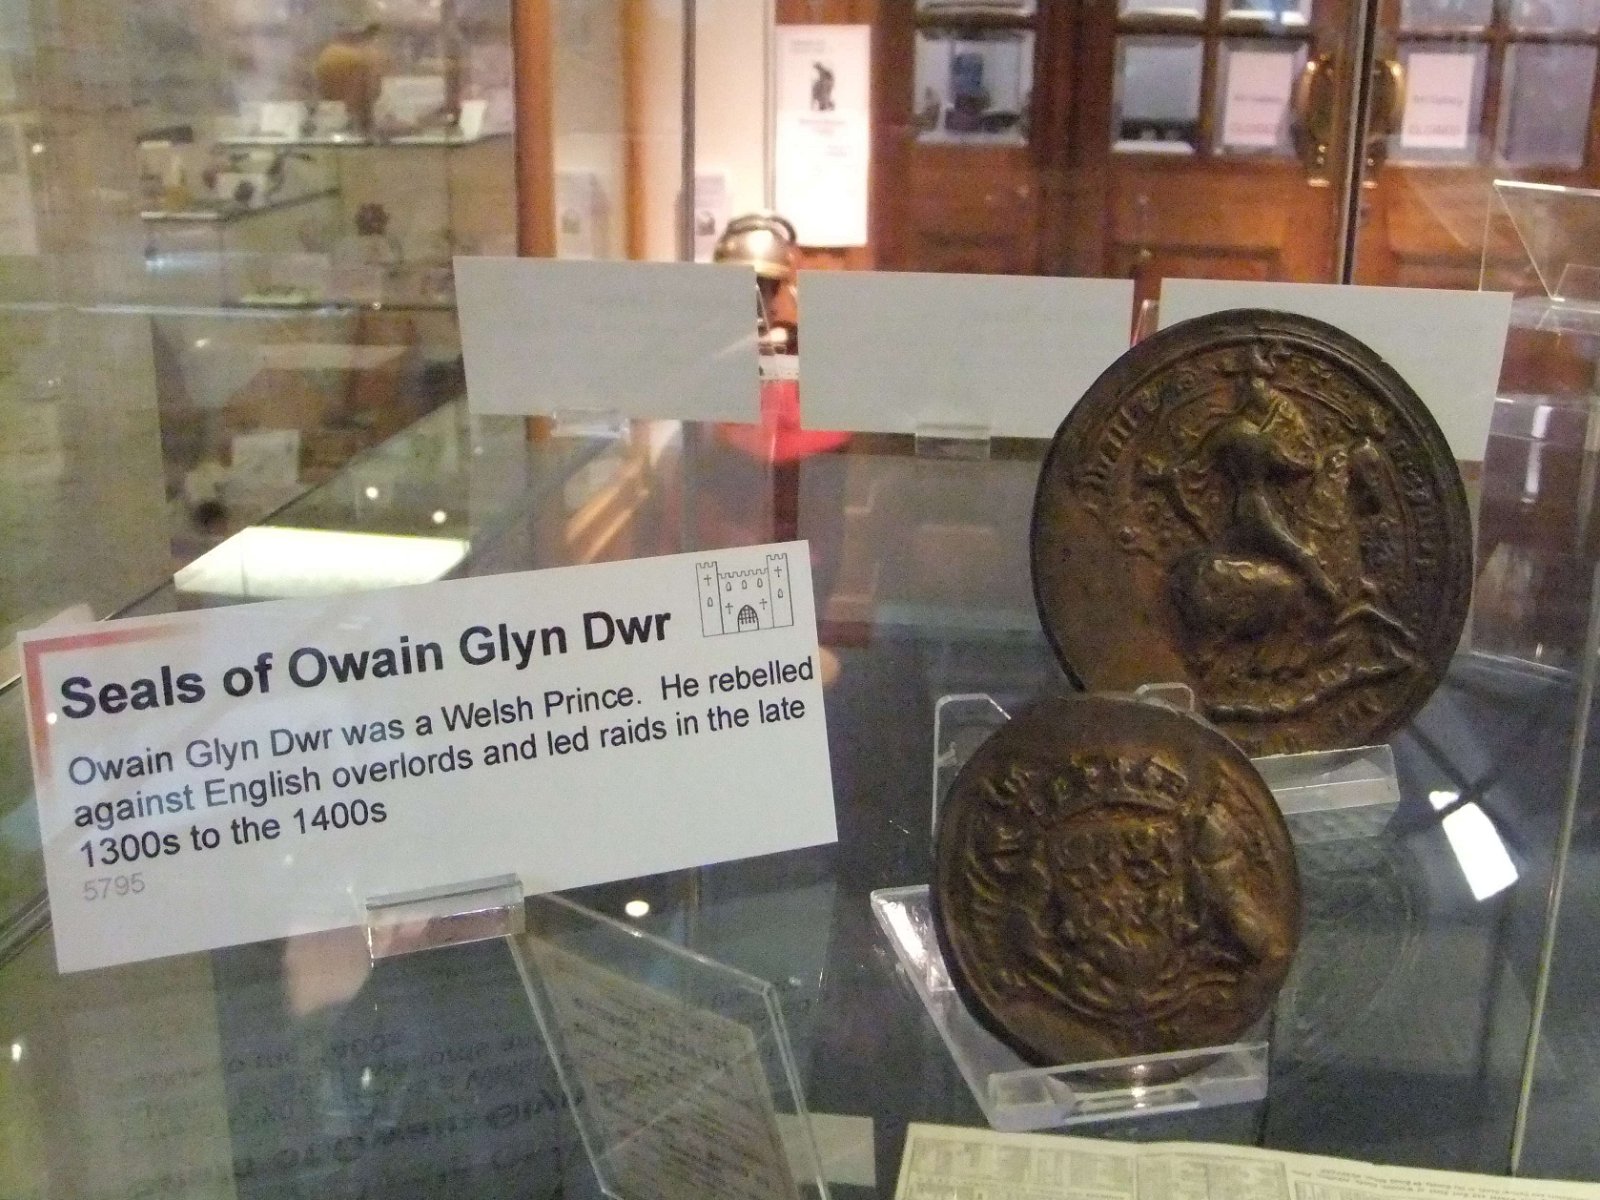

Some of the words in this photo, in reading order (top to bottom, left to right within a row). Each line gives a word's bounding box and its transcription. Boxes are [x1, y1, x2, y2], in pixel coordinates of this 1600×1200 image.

[61, 665, 206, 719] Seals
[222, 652, 274, 698] of
[287, 635, 445, 688] Owain
[458, 623, 568, 671] Glyn
[581, 611, 672, 651] Dwr
[67, 747, 174, 786] Owain
[185, 738, 260, 771] Glyn
[269, 727, 334, 757] Dwr
[340, 719, 406, 747] was
[415, 715, 434, 736] a
[439, 696, 534, 733] Welsh
[543, 686, 642, 719] Prince.
[660, 673, 700, 702] He
[708, 656, 814, 695] rebelled
[73, 784, 196, 831] against
[204, 766, 322, 808] English
[331, 745, 474, 789] overlords
[483, 733, 538, 767] and
[546, 725, 590, 757] led
[599, 716, 668, 749] raids
[675, 711, 701, 738] in
[706, 704, 750, 732] the
[758, 696, 806, 725] late
[80, 828, 182, 868] 1300s
[189, 823, 221, 852] to
[229, 815, 281, 846] the
[292, 799, 388, 835] 1400s
[83, 872, 146, 902] 5795
